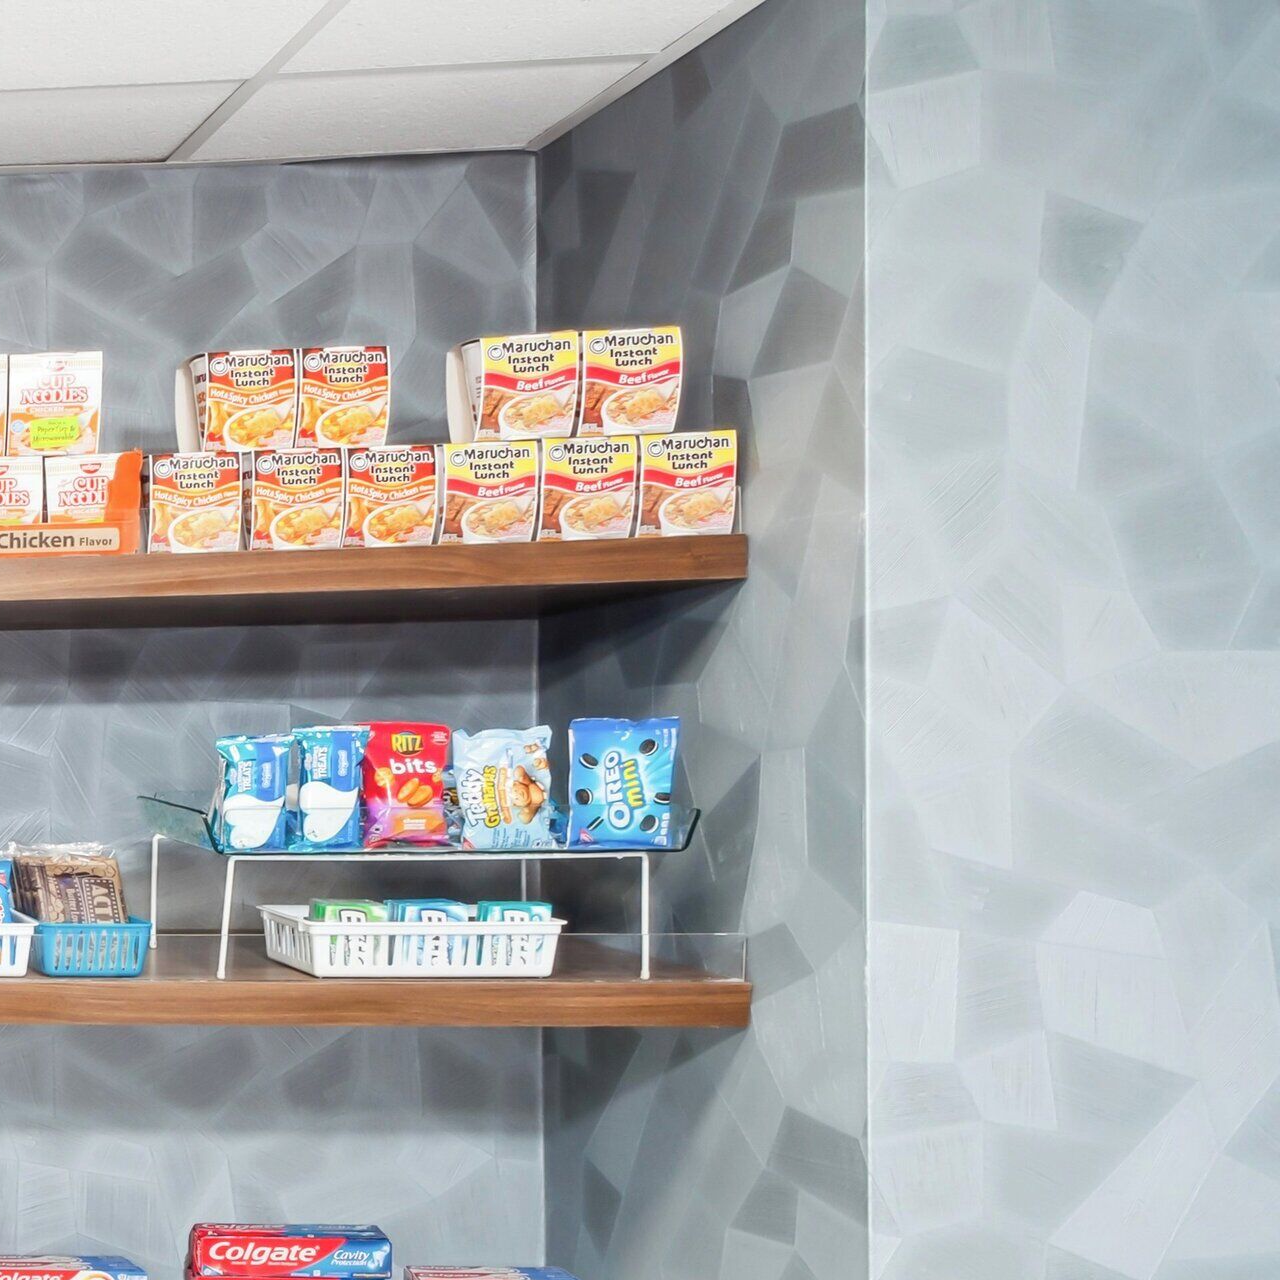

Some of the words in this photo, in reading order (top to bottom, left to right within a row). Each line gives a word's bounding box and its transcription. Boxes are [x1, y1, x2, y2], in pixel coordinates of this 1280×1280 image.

[503, 339, 571, 353] Maruchan
[606, 333, 673, 347] Maruchan
[320, 353, 382, 363] Maruchan
[610, 348, 657, 357] Instant
[226, 355, 290, 367] Maruchan
[508, 355, 554, 364] Instant
[616, 357, 652, 366] Lunch
[231, 369, 274, 378] Instant
[324, 365, 367, 374] Instant
[513, 364, 549, 372] Lunch
[619, 372, 646, 384] Beef
[517, 379, 544, 391] Beef
[20, 387, 88, 405] NOODLES
[249, 391, 279, 403] Chicken
[342, 388, 372, 399] Chicken
[563, 442, 630, 454] Maruchan
[662, 436, 729, 449] Maruchan
[272, 453, 339, 466] Maruchan
[366, 452, 431, 464] Maruchan
[465, 447, 530, 460] Maruchan
[667, 451, 713, 461] Instant
[169, 458, 237, 470] Maruchan
[469, 461, 515, 470] Instant
[568, 456, 613, 466] Instant
[671, 459, 708, 469] Lunch
[174, 471, 220, 480] Instant
[277, 467, 321, 477] Instant
[370, 465, 415, 474] Instant
[474, 469, 510, 479] Lunch
[573, 465, 609, 474] Lunch
[282, 475, 316, 485] Lunch
[375, 473, 410, 483] Lunch
[674, 476, 701, 488] Beef
[73, 476, 110, 493] CUP
[179, 480, 214, 489] Lunch
[575, 480, 603, 493] Beef
[295, 487, 325, 502] Chicken
[389, 484, 419, 500] Chicken
[477, 484, 505, 498] Beef
[193, 491, 224, 506] Chicken
[79, 537, 112, 546] Flavor
[391, 733, 423, 752] RITZ
[390, 758, 437, 774] bits
[605, 751, 630, 829] OREO
[623, 759, 645, 809] mini
[460, 768, 485, 827] Teddy
[483, 765, 501, 828] Grahams
[90, 884, 113, 916] ACT
[209, 1242, 317, 1265] Colgate
[333, 1250, 370, 1260] Cavity
[330, 1258, 367, 1266] Protection
